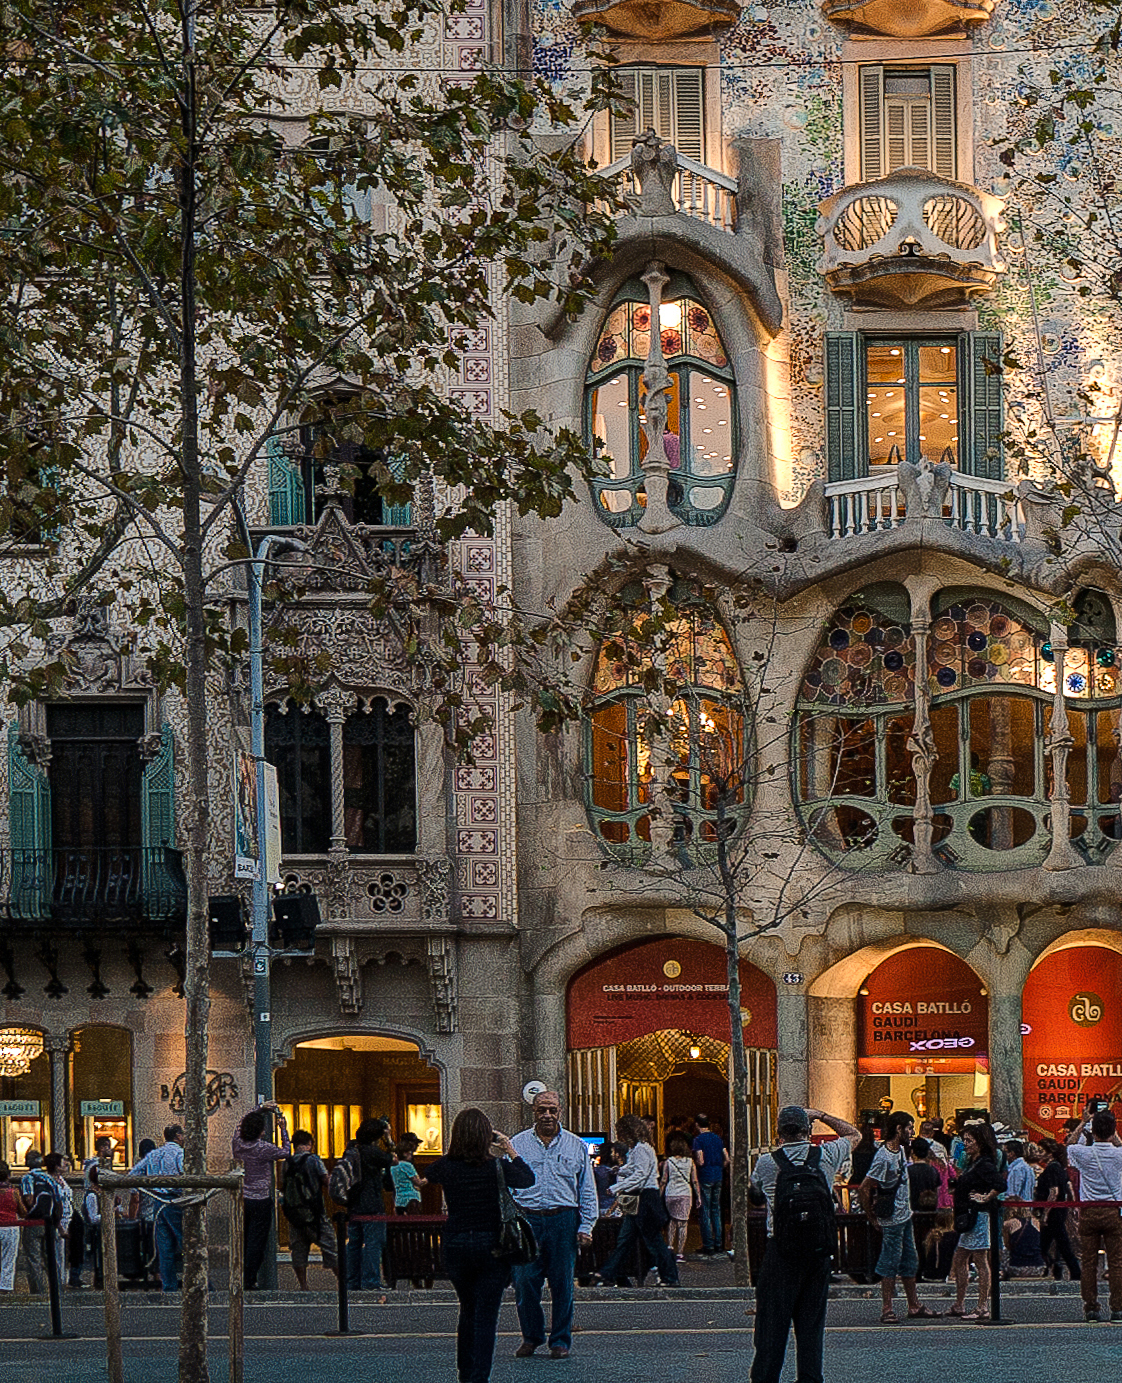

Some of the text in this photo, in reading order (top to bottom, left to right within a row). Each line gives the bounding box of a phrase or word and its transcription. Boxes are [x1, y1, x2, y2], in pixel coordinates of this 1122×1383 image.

[603, 984, 625, 992] CASA
[663, 984, 703, 992] OUTDOOR
[704, 984, 742, 992] TERRAE
[871, 999, 972, 1014] CASA BATLLÓ
[873, 1030, 961, 1042] BARCELONA
[1036, 1064, 1078, 1077] CASA
